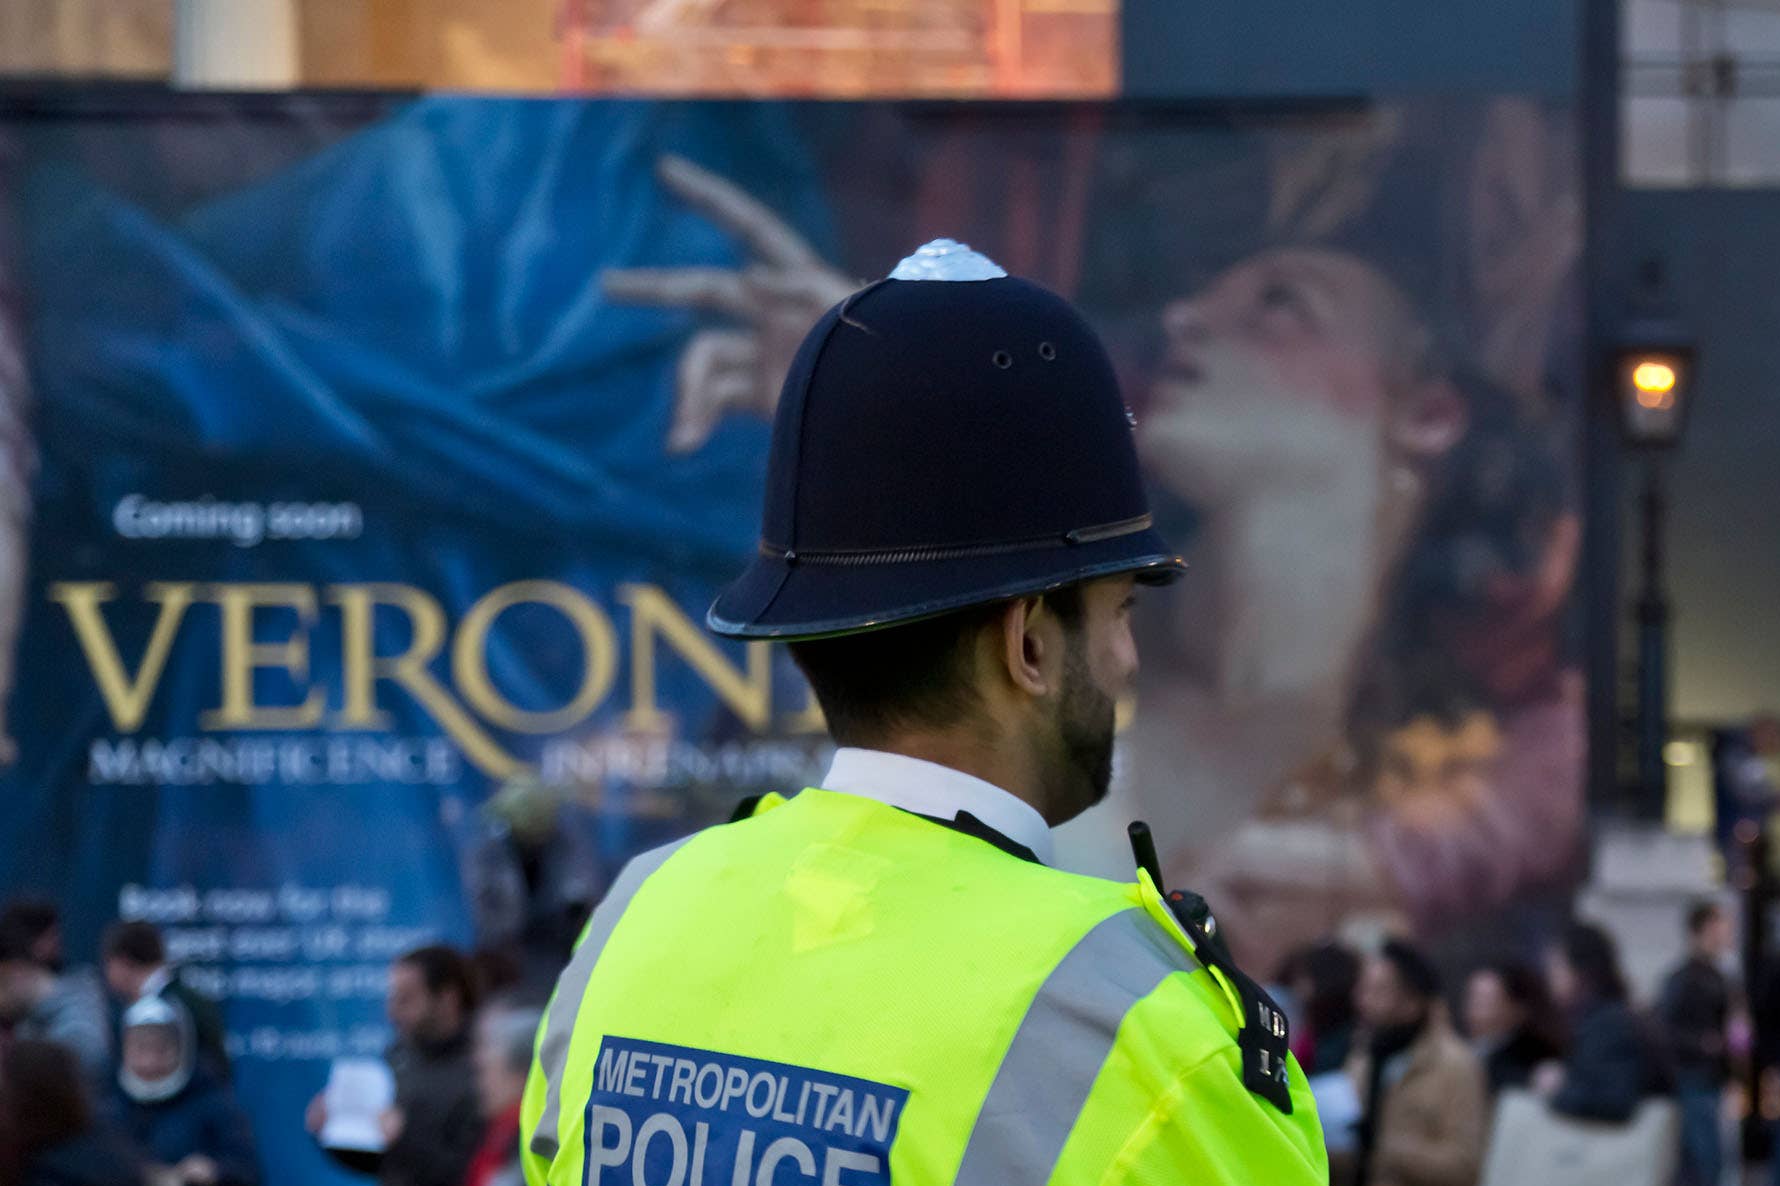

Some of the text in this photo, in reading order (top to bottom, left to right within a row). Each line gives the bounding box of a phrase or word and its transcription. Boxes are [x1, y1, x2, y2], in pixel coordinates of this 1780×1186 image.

[114, 494, 362, 545] Coming soon
[50, 580, 829, 785] VERON
[598, 1048, 895, 1142] METROPOLITAN
